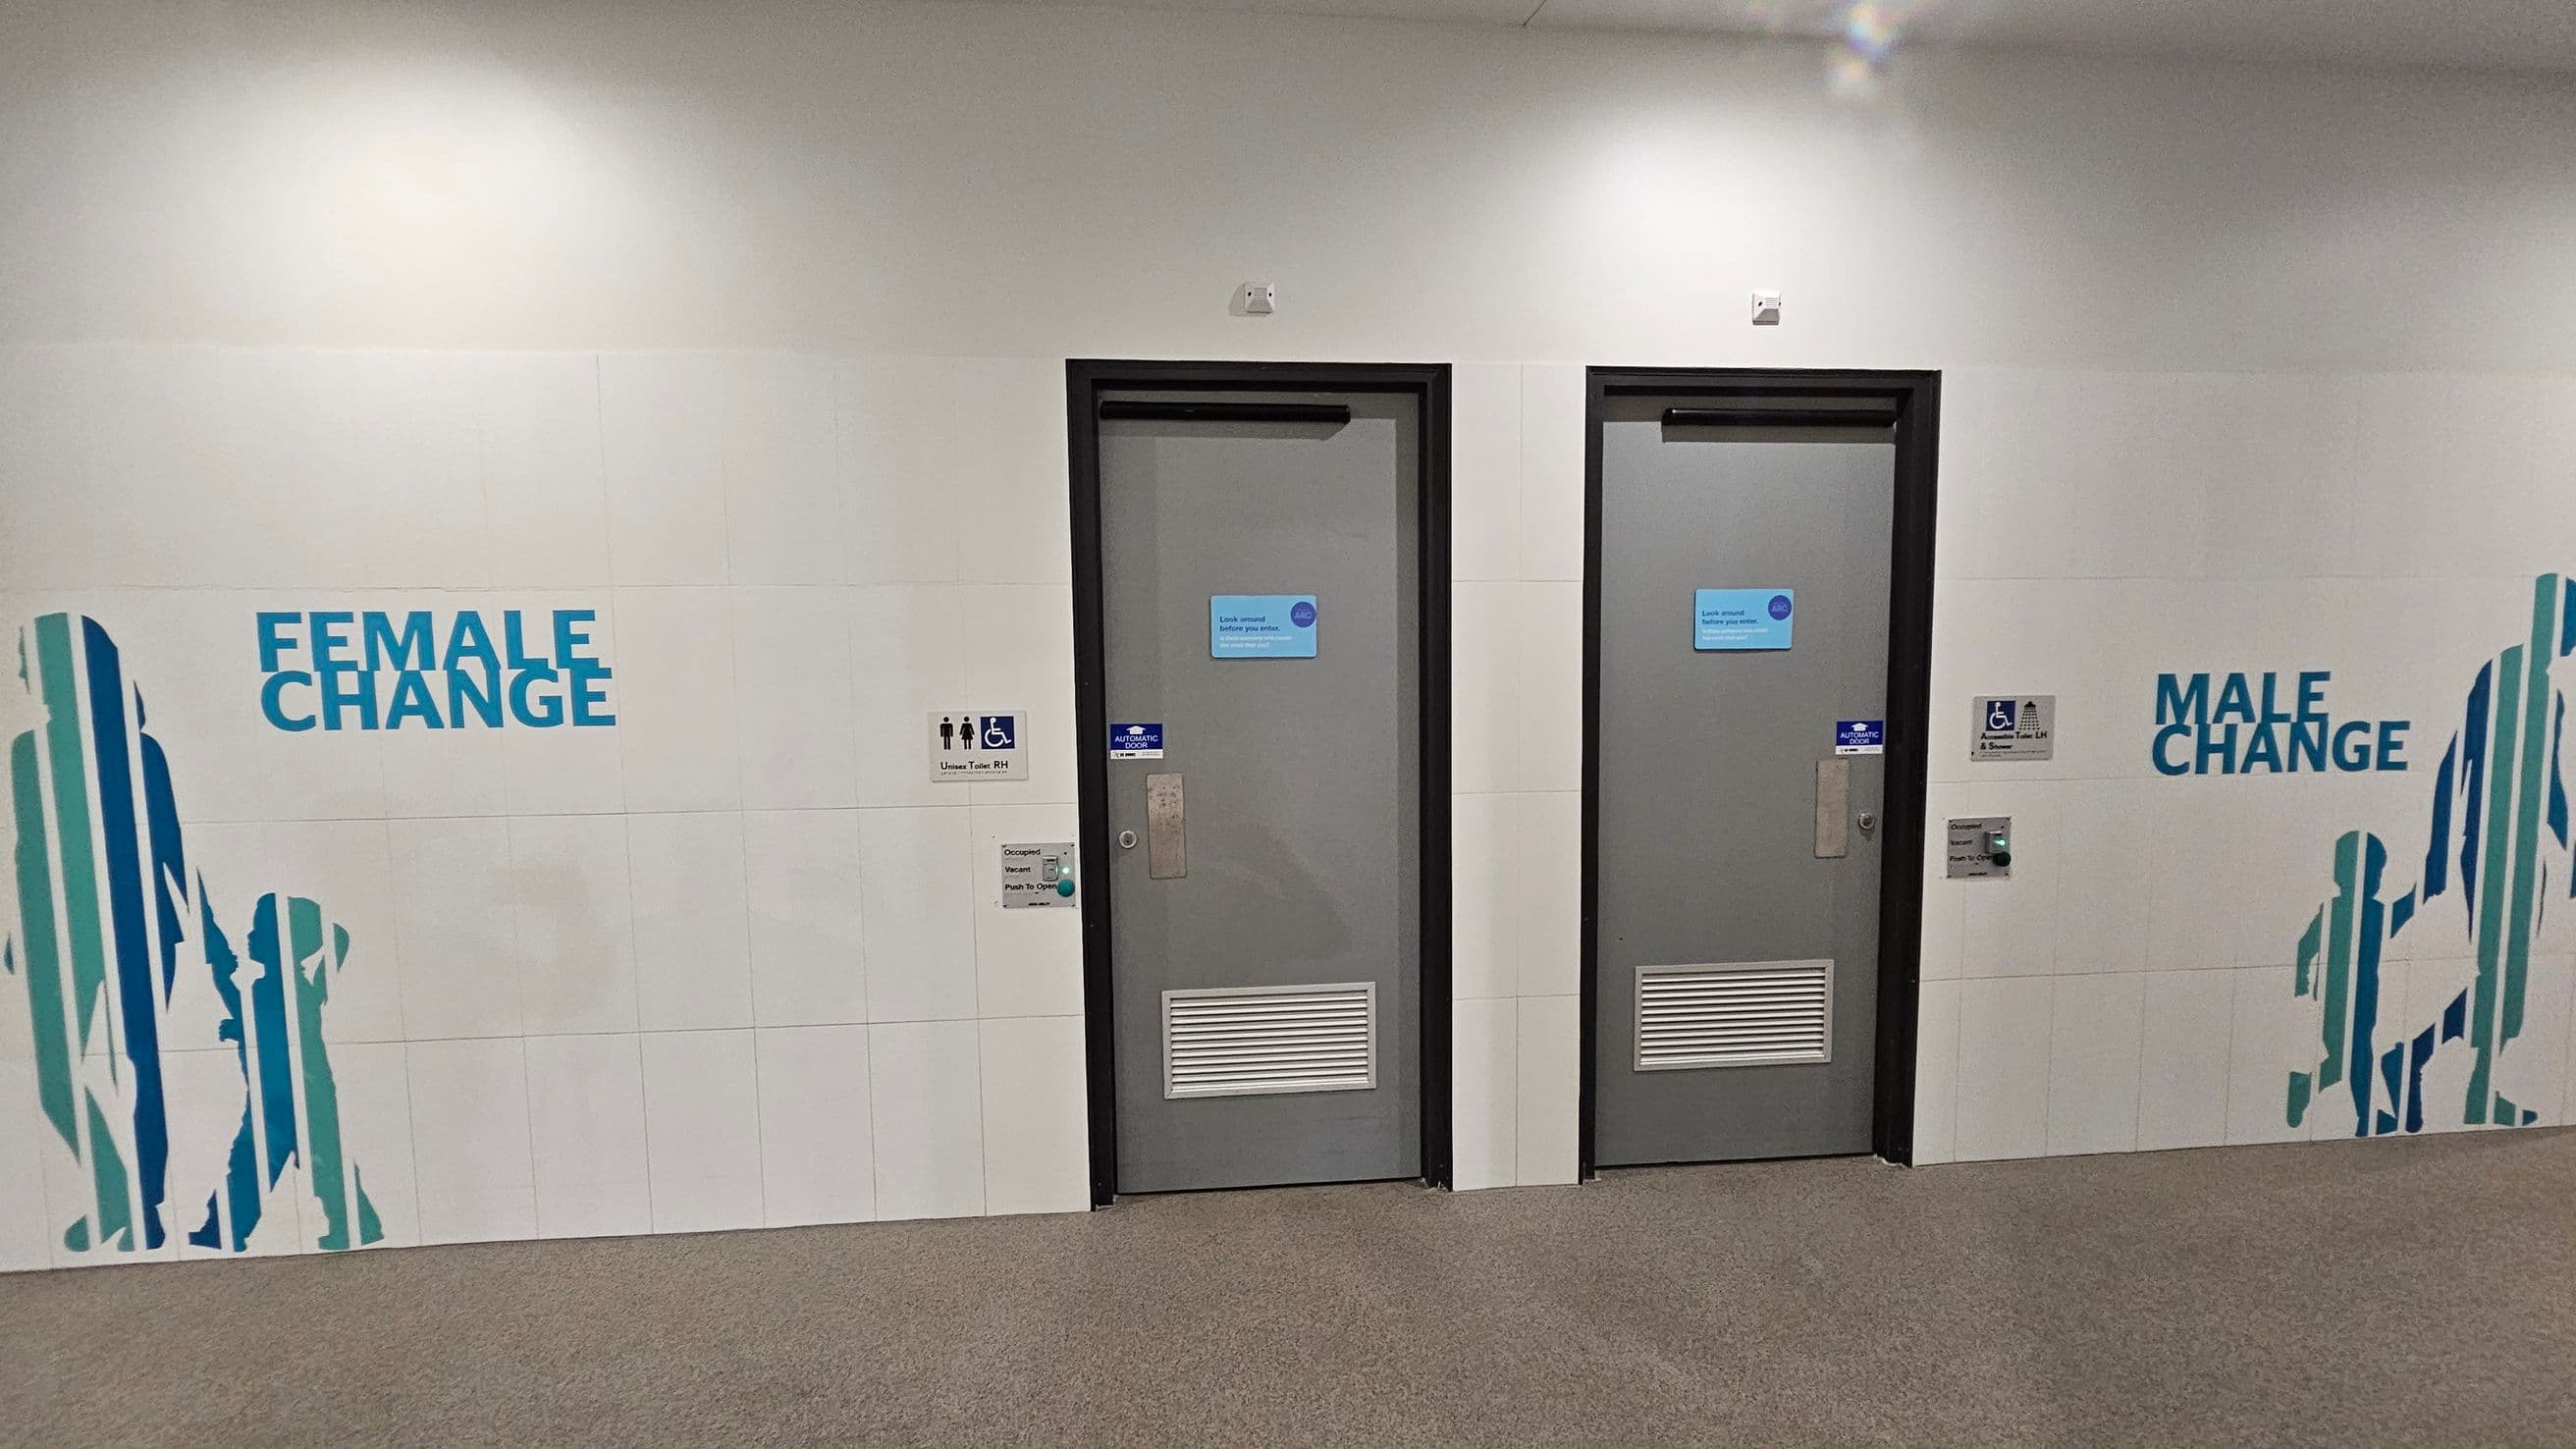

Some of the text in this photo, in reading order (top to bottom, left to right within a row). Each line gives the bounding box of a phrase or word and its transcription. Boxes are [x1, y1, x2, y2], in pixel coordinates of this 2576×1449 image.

[255, 609, 601, 672] FEMALE
[260, 667, 617, 732] CHANGE
[2155, 671, 2332, 725] MALE
[940, 760, 1009, 771] Unisex Toilet RH
[1114, 734, 1158, 743] AUTOMATIC
[2152, 720, 2412, 777] CHANGE
